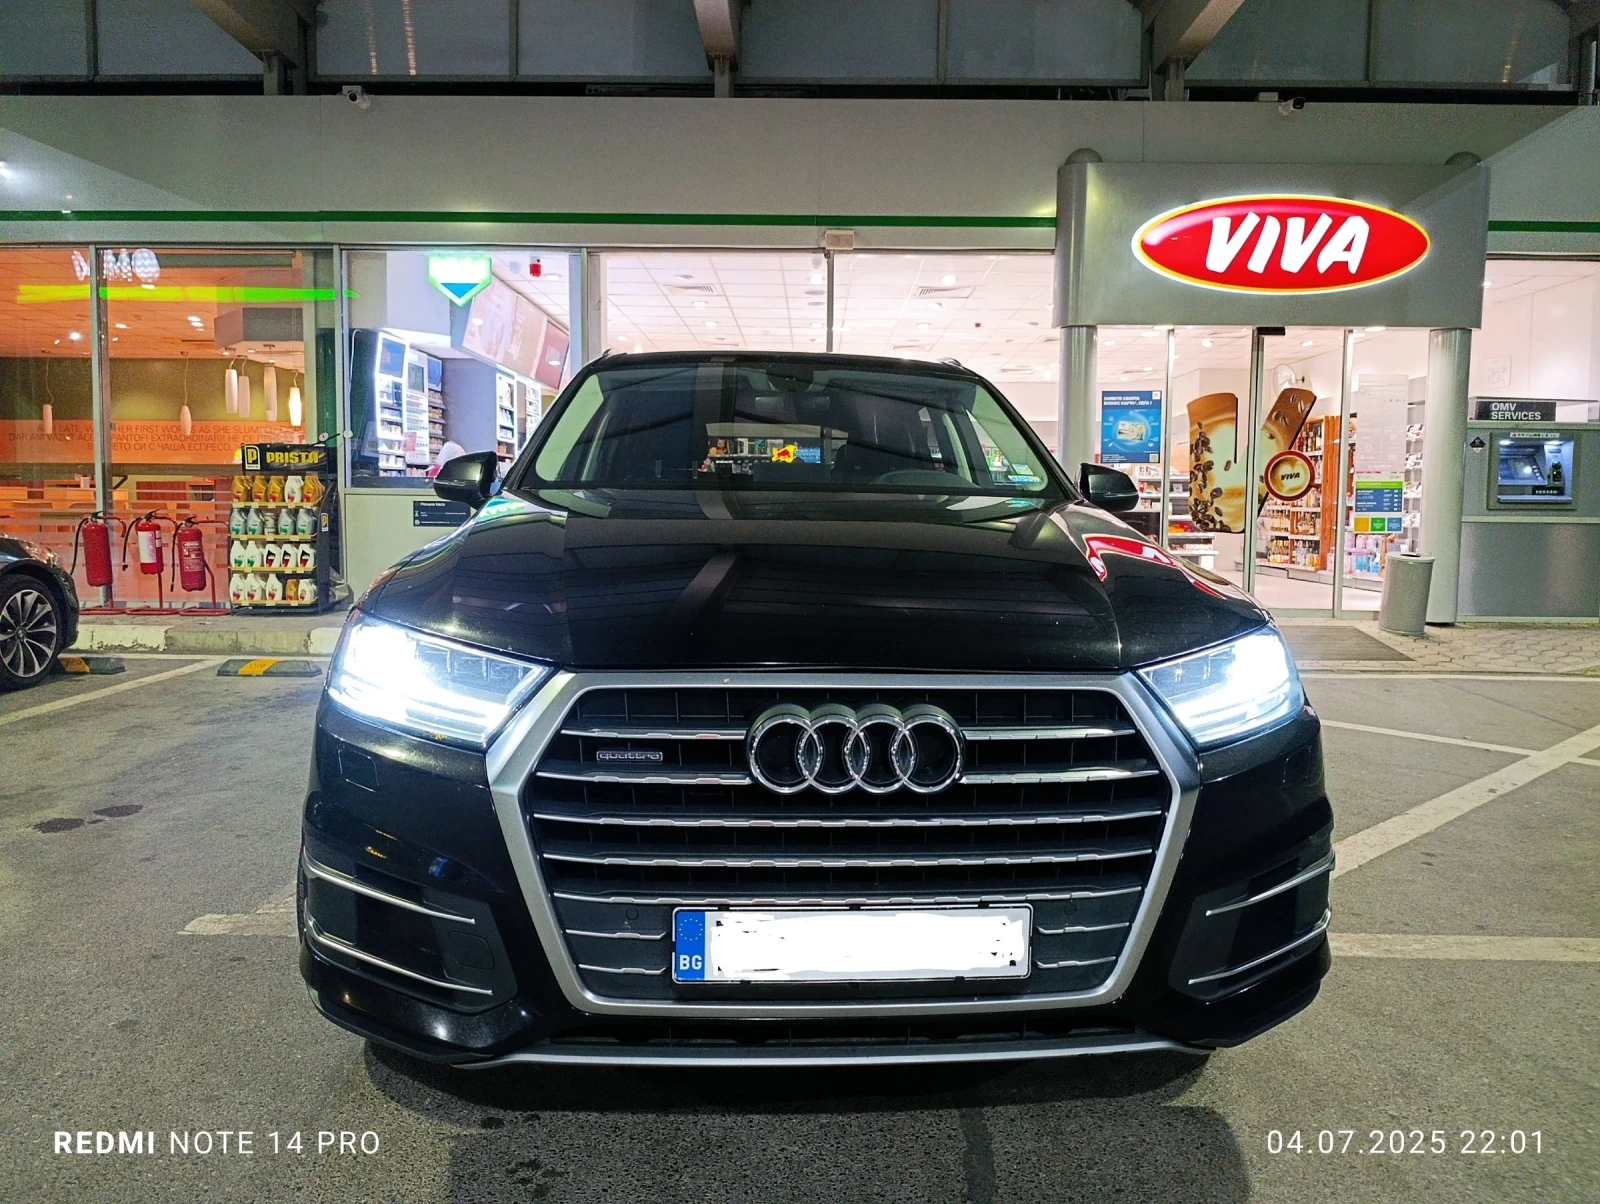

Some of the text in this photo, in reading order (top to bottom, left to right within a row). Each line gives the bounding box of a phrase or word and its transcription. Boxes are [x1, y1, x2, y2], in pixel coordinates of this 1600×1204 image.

[1205, 211, 1370, 275] VIVA
[1491, 402, 1517, 411] OMV
[1491, 411, 1541, 420] SERVICES
[135, 425, 158, 433] FIRST
[213, 425, 231, 434] SHE
[266, 452, 319, 464] PRISTA
[1281, 472, 1300, 481] VIVA
[599, 752, 660, 760] quattro
[679, 954, 702, 970] BG
